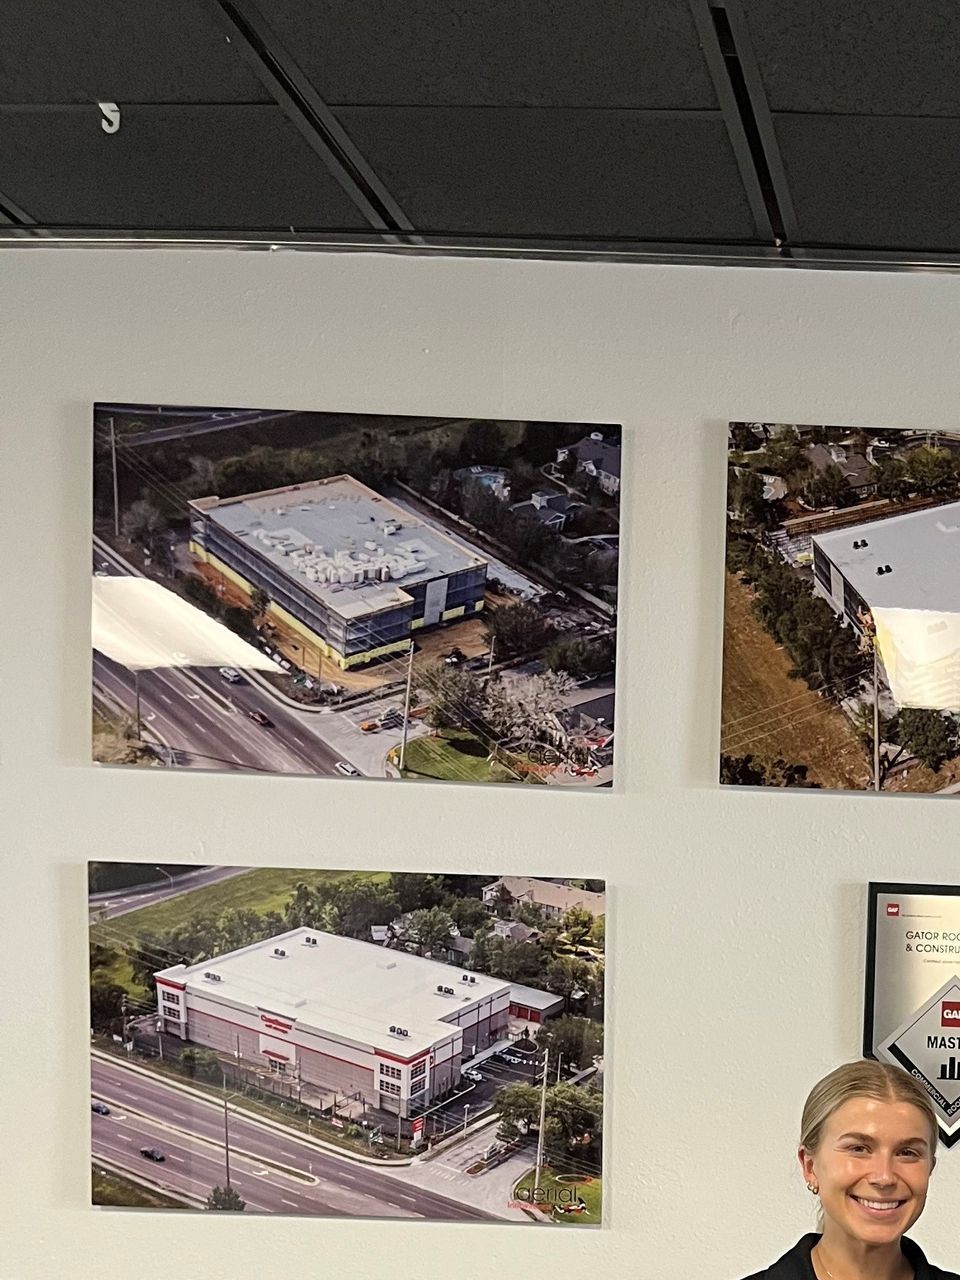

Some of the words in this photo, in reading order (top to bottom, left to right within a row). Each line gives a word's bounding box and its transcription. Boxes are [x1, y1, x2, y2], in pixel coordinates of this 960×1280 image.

[905, 931, 939, 941] GATOR
[905, 943, 913, 953] &
[911, 1068, 947, 1109] COMMERCIAL
[516, 1184, 577, 1203] aerial
